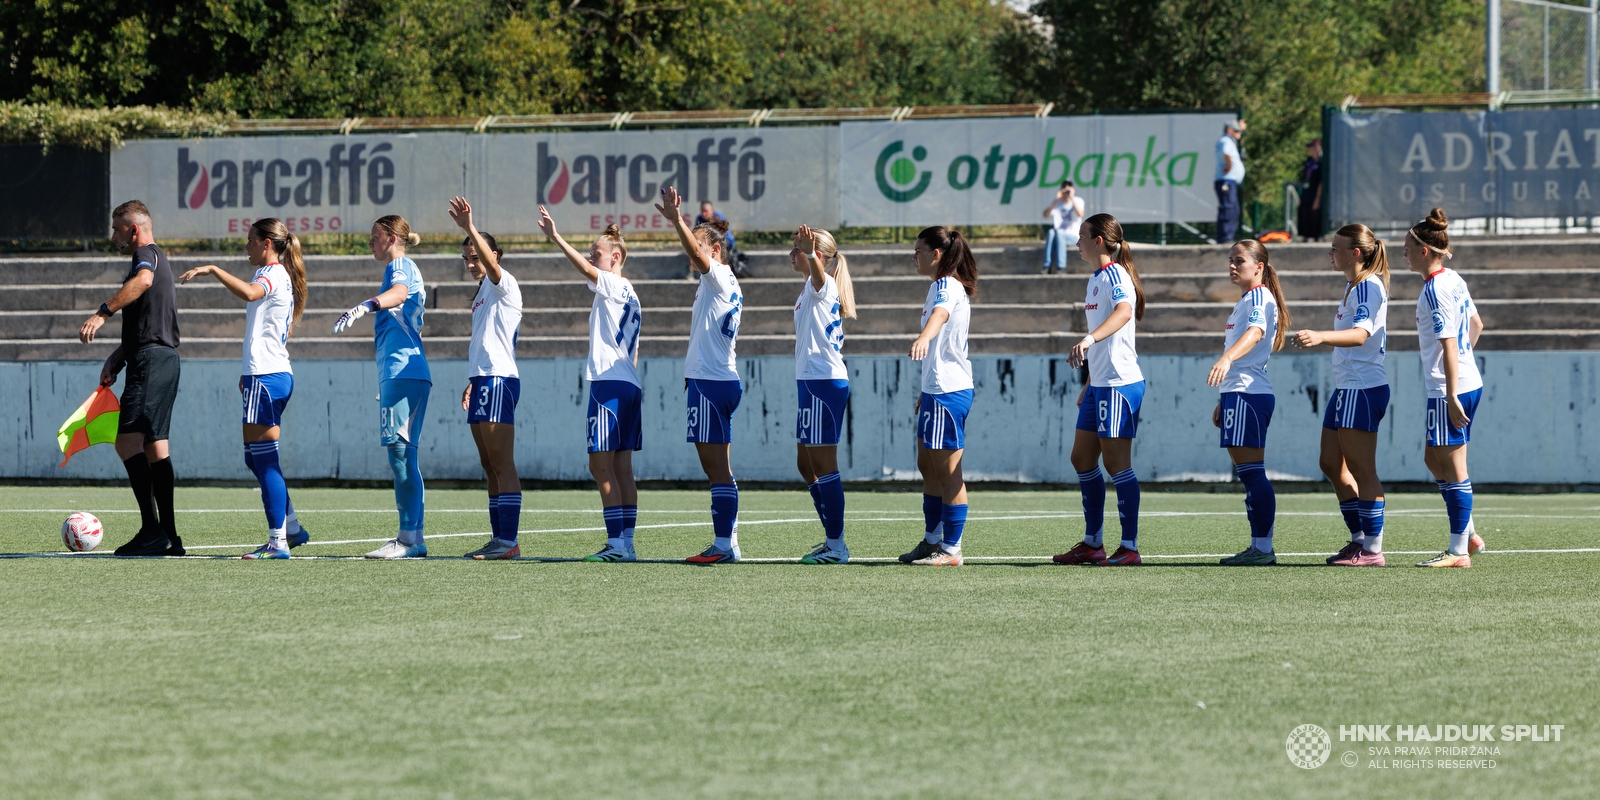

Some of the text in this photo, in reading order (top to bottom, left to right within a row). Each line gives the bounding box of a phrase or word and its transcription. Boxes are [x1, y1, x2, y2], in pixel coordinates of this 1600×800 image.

[178, 142, 395, 209] barcaffé
[536, 137, 766, 205] barcaffé
[1401, 180, 1592, 203] OSIGURA
[228, 217, 342, 233] ESESSO
[590, 213, 693, 230] ESPRES
[479, 386, 489, 406] 3
[381, 407, 395, 427] 81
[1098, 400, 1108, 421] 6
